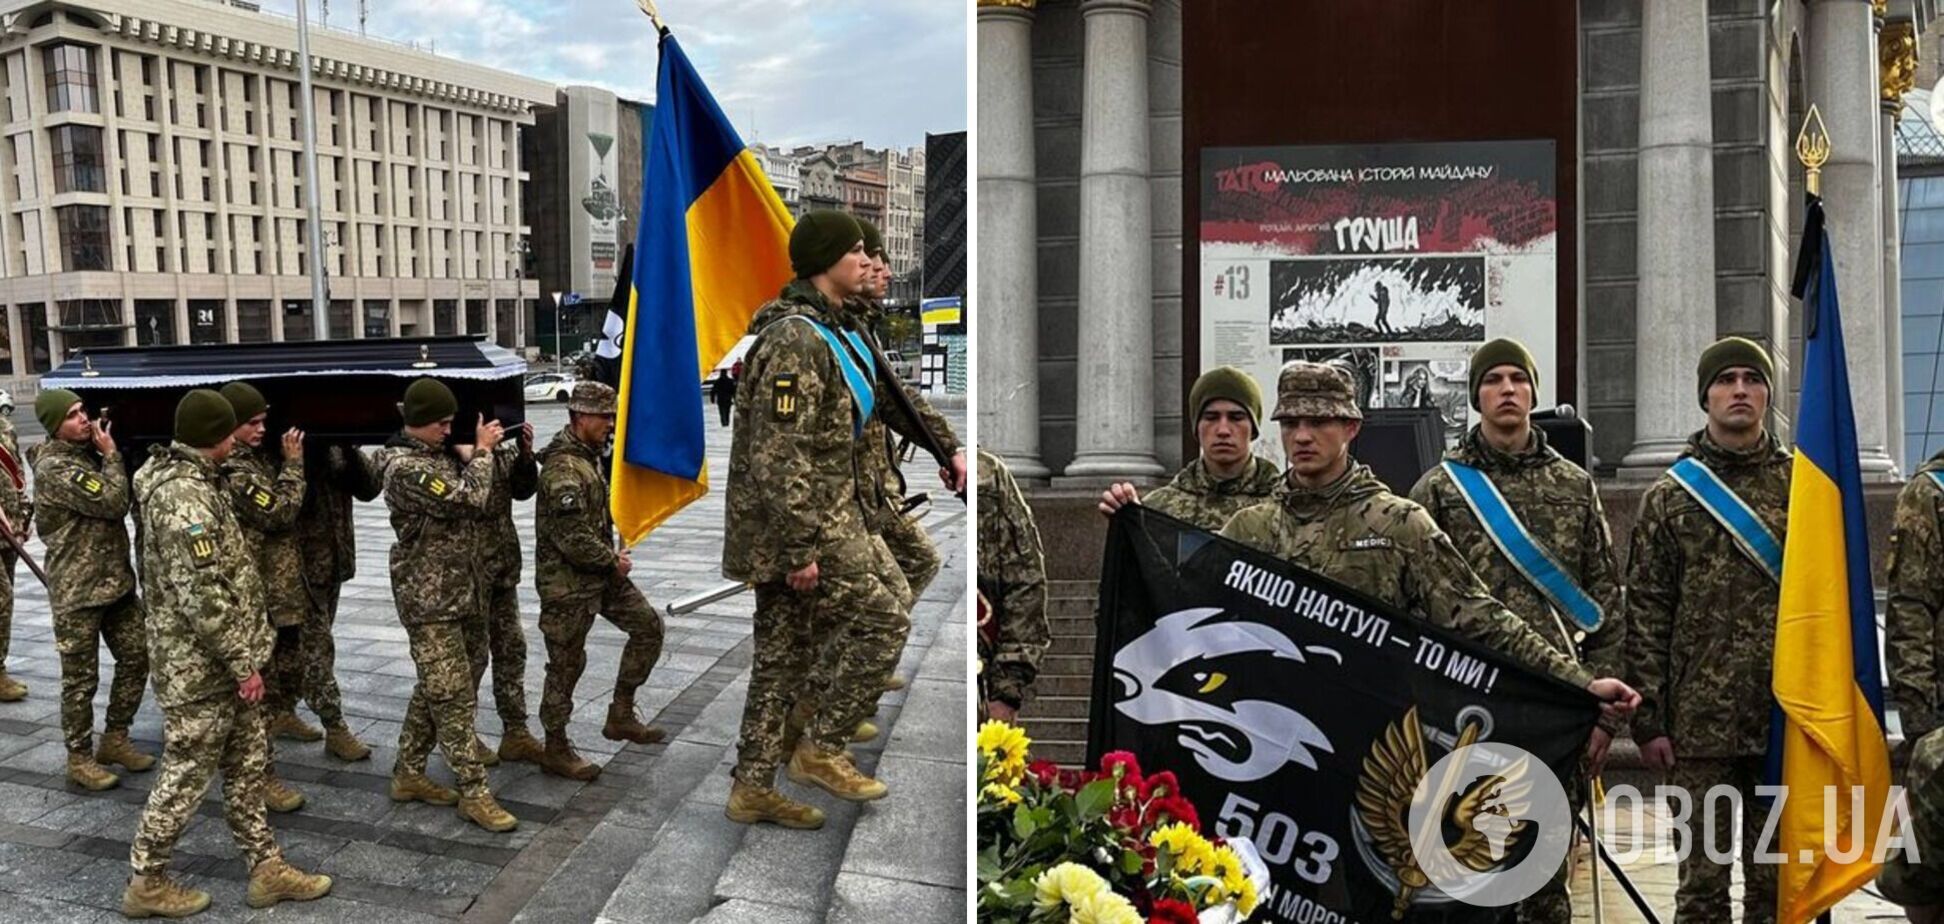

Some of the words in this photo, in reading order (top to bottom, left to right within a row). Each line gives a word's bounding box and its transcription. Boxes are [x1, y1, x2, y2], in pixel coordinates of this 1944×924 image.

[1264, 168, 1355, 183] МАЛЬОВАНА
[1358, 166, 1416, 182] ІСТОРІЯ
[1419, 164, 1494, 181] МАЙДАНУ
[1333, 216, 1420, 252] ГРУША
[1214, 265, 1250, 300] #13
[1355, 537, 1388, 548] MEDIC
[1224, 559, 1296, 608] ЯКЩО
[1294, 586, 1391, 648] НАСТУП
[1414, 635, 1446, 671] ТО
[1444, 650, 1487, 689] МИ
[1215, 792, 1340, 884] 503
